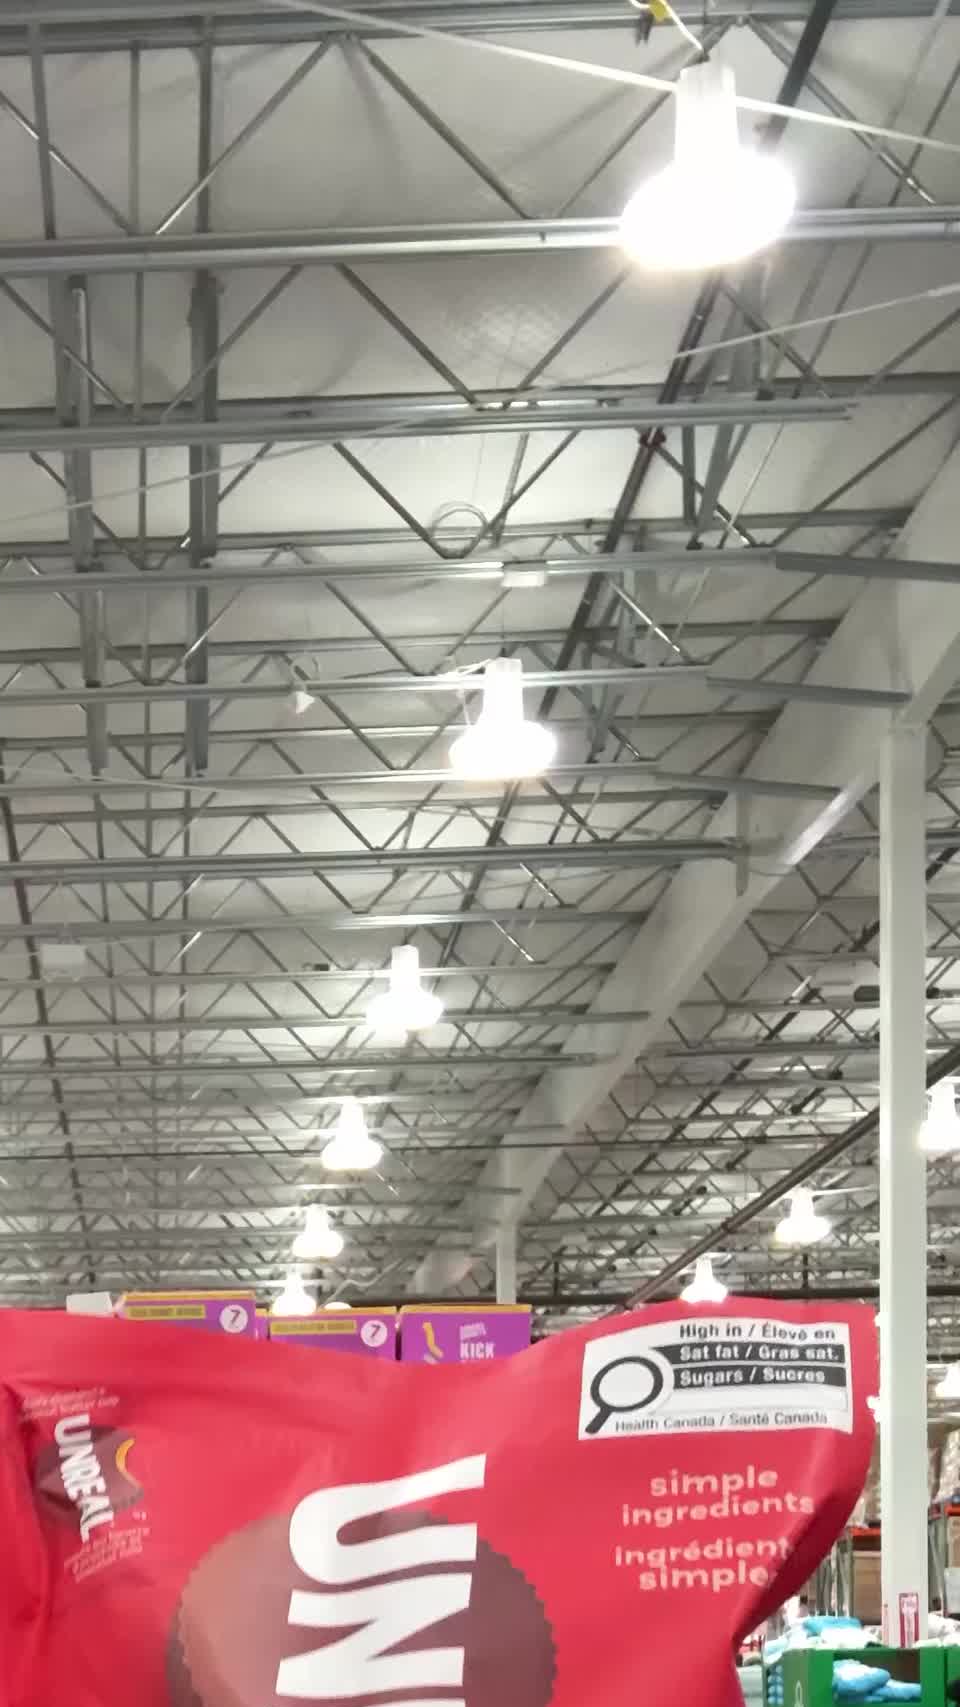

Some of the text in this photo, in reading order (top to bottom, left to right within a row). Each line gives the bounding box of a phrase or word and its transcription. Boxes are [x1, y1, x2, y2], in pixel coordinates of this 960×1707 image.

[679, 1321, 836, 1341] High in / Élevé en
[679, 1343, 840, 1361] Sat fat / Gras sat.
[679, 1366, 826, 1387] Sugars / Sucres
[615, 1416, 659, 1432] Health
[663, 1413, 715, 1429] Canada
[729, 1412, 770, 1426] Santé
[773, 1409, 828, 1425] Canada
[649, 1464, 779, 1497] simple
[622, 1491, 816, 1528] ingredients
[614, 1536, 790, 1568] ingrédient
[638, 1559, 777, 1592] simple
